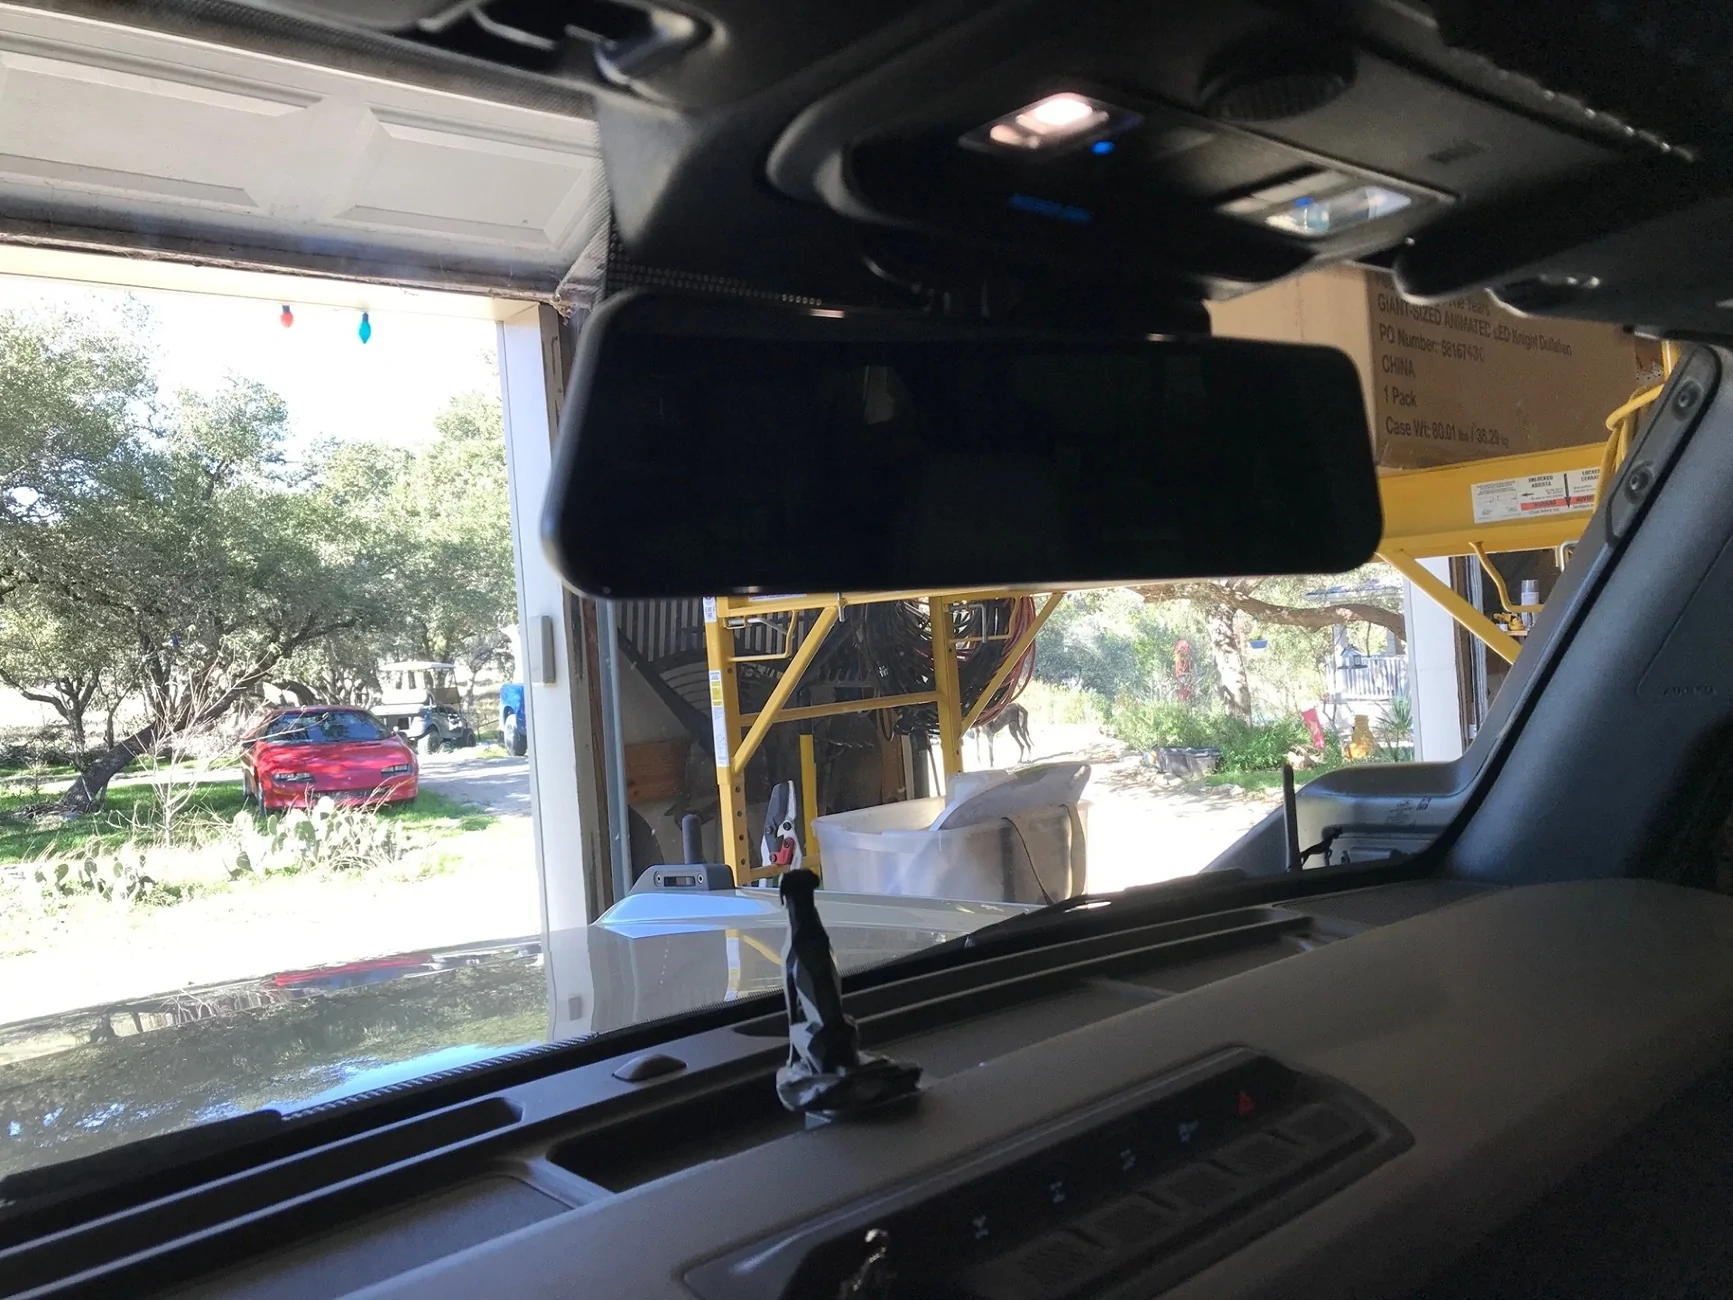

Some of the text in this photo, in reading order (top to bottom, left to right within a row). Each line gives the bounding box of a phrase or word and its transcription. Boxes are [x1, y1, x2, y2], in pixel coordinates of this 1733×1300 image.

[1377, 293, 1441, 326] GIANT-SIZED
[1444, 310, 1491, 337] ANIMATED
[1379, 323, 1395, 344] PO
[1398, 329, 1440, 353] Number:
[1382, 354, 1416, 378] CHINA
[1384, 386, 1417, 407] 1 Pack
[1386, 416, 1411, 436] Case
[1432, 422, 1455, 440] 80.01
